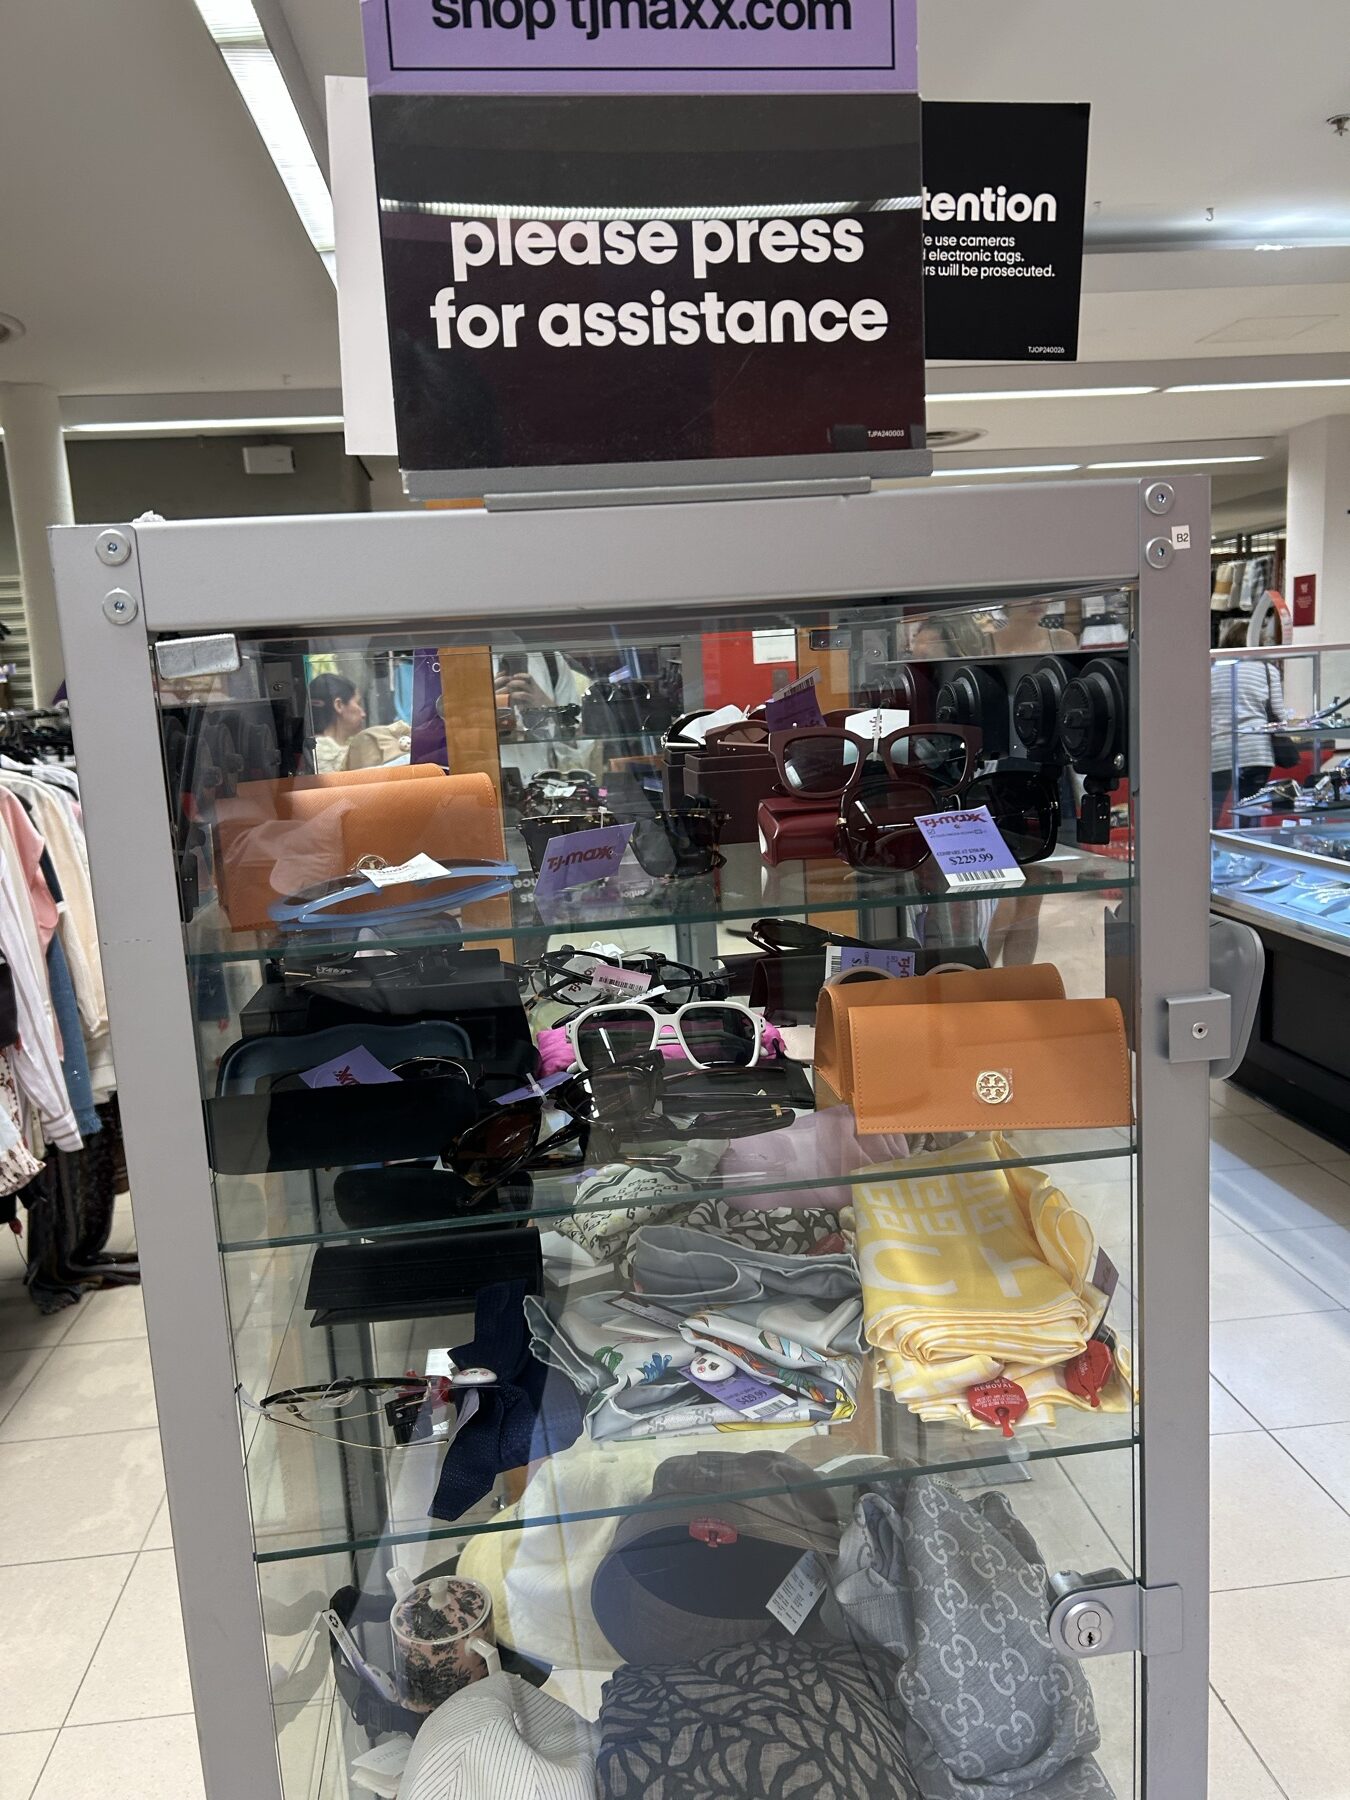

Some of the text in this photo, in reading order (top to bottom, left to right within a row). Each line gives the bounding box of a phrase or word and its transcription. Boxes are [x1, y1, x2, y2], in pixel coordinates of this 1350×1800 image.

[432, 0, 852, 40] shop tjmaxx.com
[450, 213, 865, 282] please press
[935, 236, 957, 247] use
[959, 236, 1016, 247] cameras
[928, 249, 992, 262] electronic
[994, 251, 1025, 265] tags.
[938, 264, 960, 277] will
[961, 265, 979, 277] be
[980, 264, 1056, 279] prosecuted.
[429, 287, 889, 349] for assistance
[1027, 346, 1066, 354] TJOP240026
[867, 429, 905, 438] TJPA240003
[1176, 532, 1189, 543] B2
[948, 852, 994, 866] $229.99
